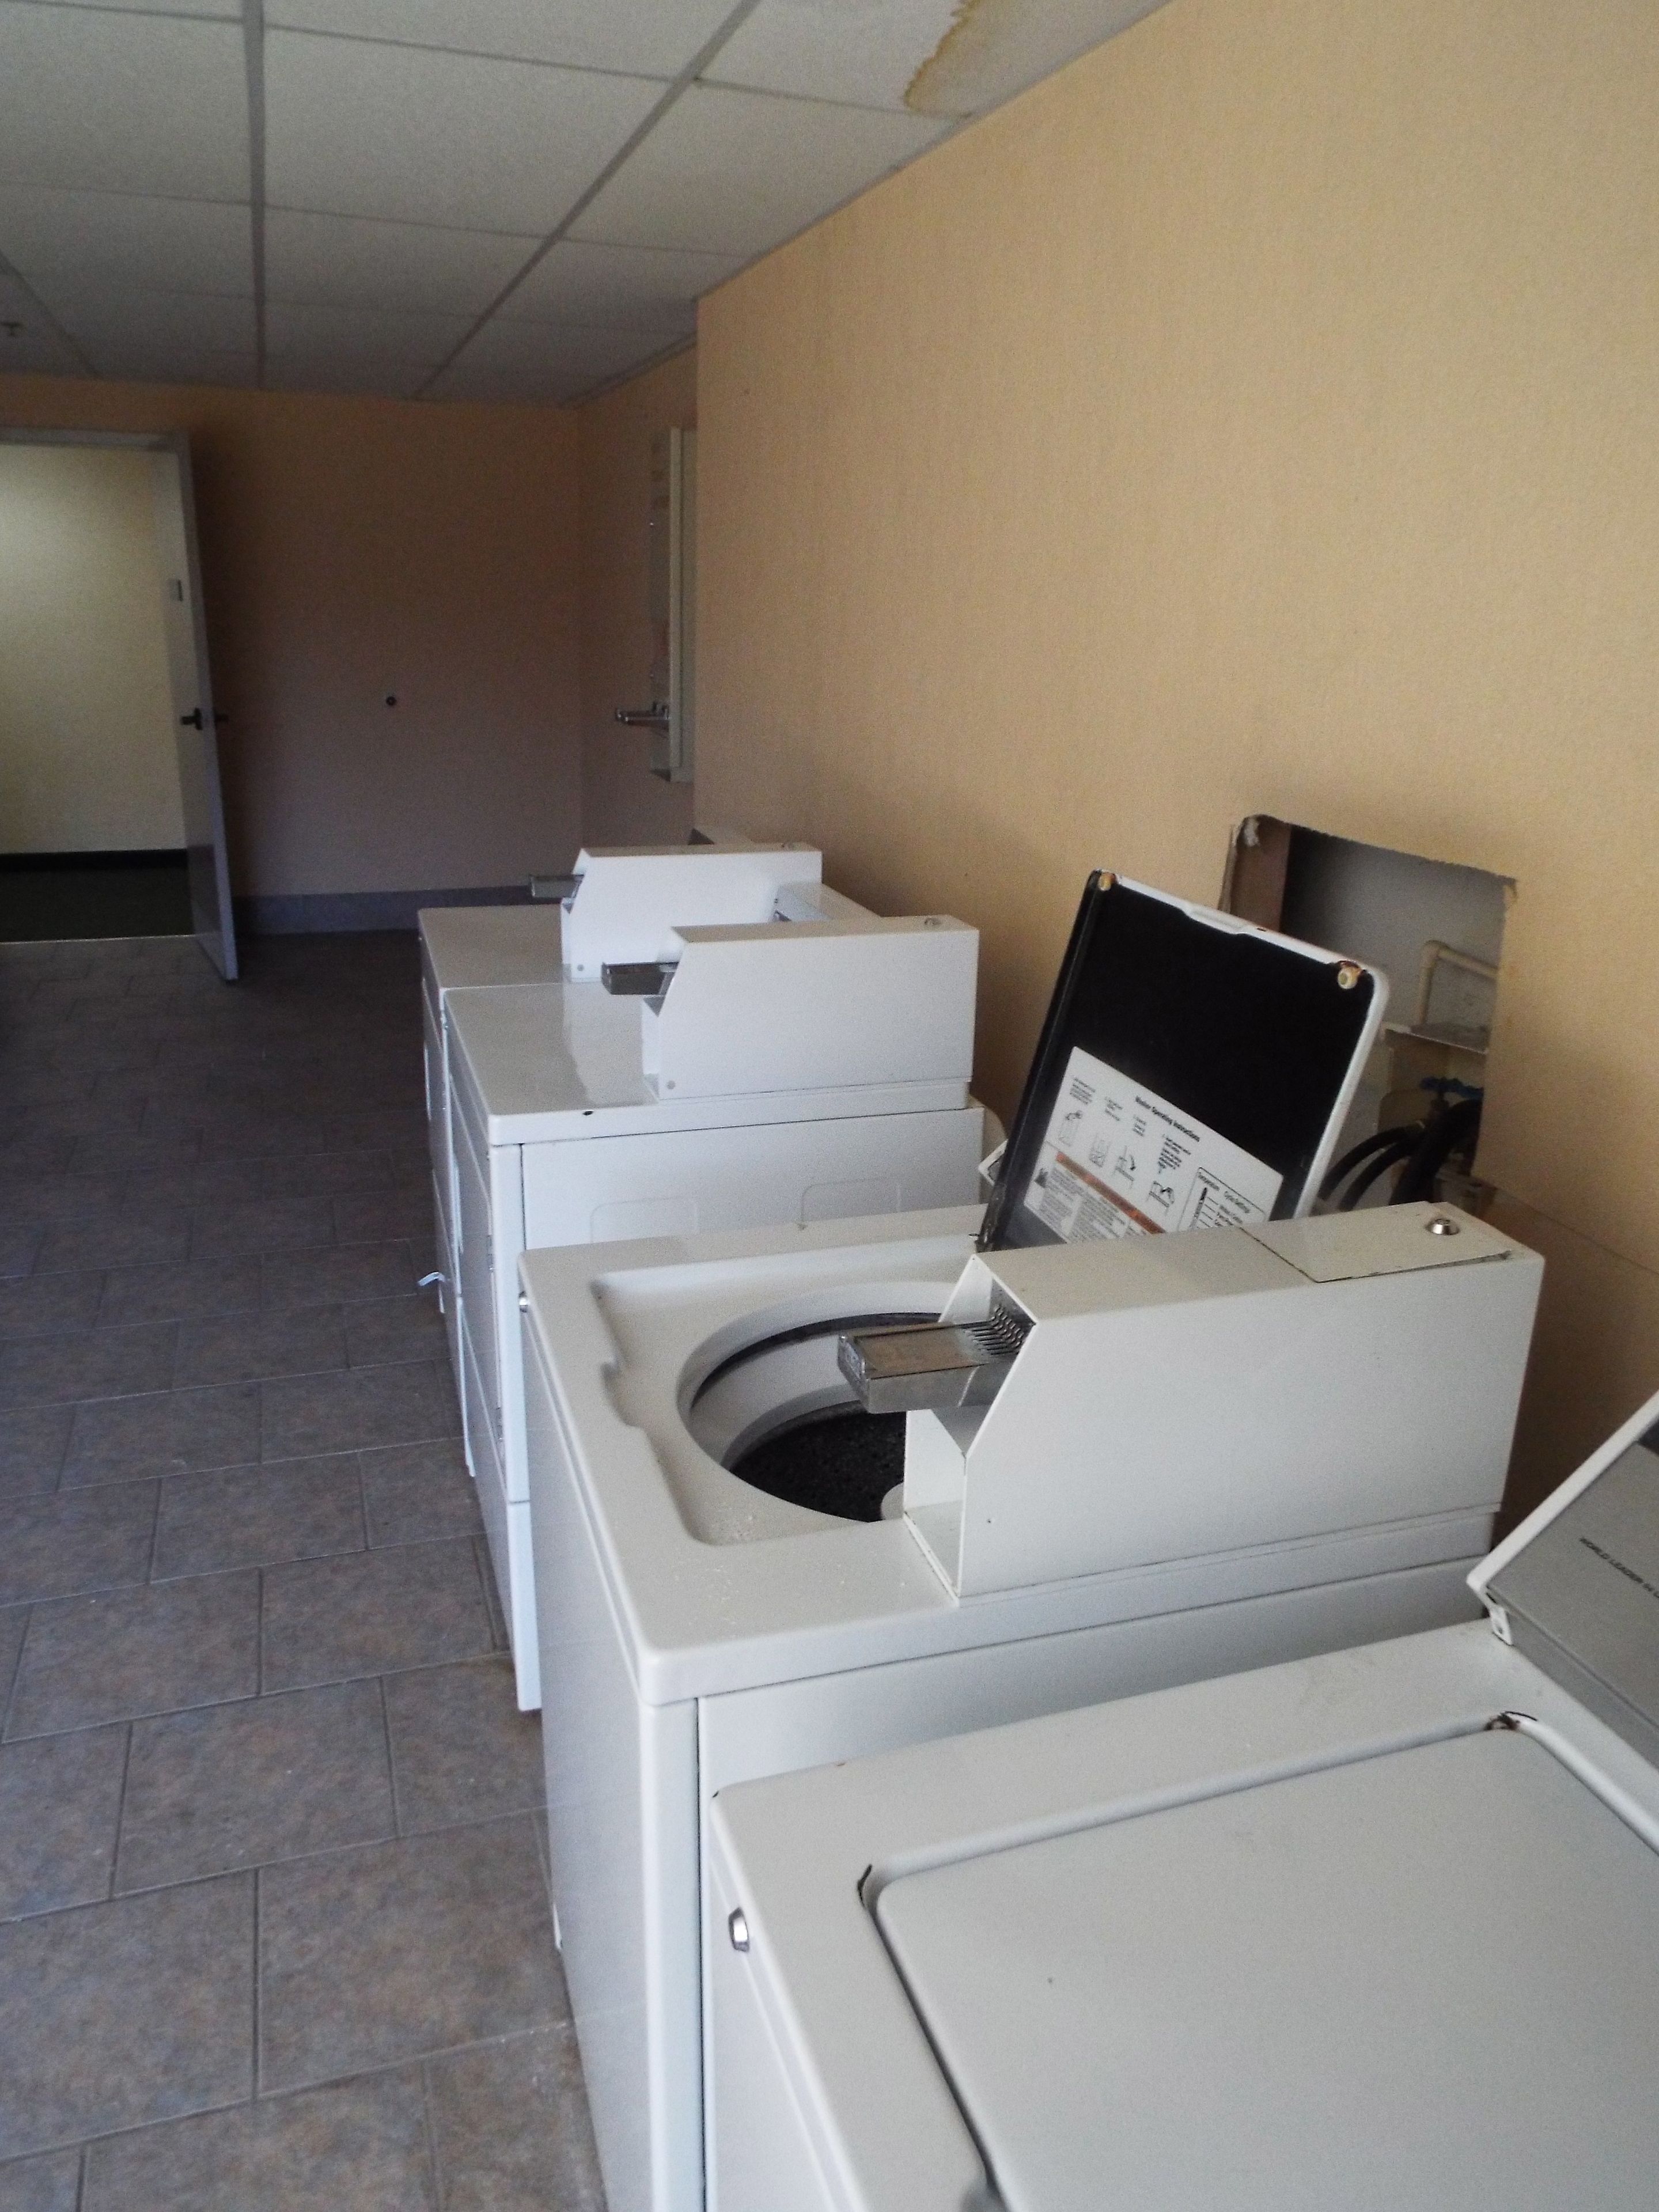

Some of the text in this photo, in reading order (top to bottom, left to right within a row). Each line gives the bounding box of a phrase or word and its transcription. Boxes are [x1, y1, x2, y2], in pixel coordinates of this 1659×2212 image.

[1152, 1106, 1173, 1125] Operating
[1173, 1120, 1200, 1143] Instructions
[1580, 1538, 1610, 1559] WORLD
[1608, 1559, 1643, 1584] LEADER
[1642, 1583, 1654, 1592] IN
